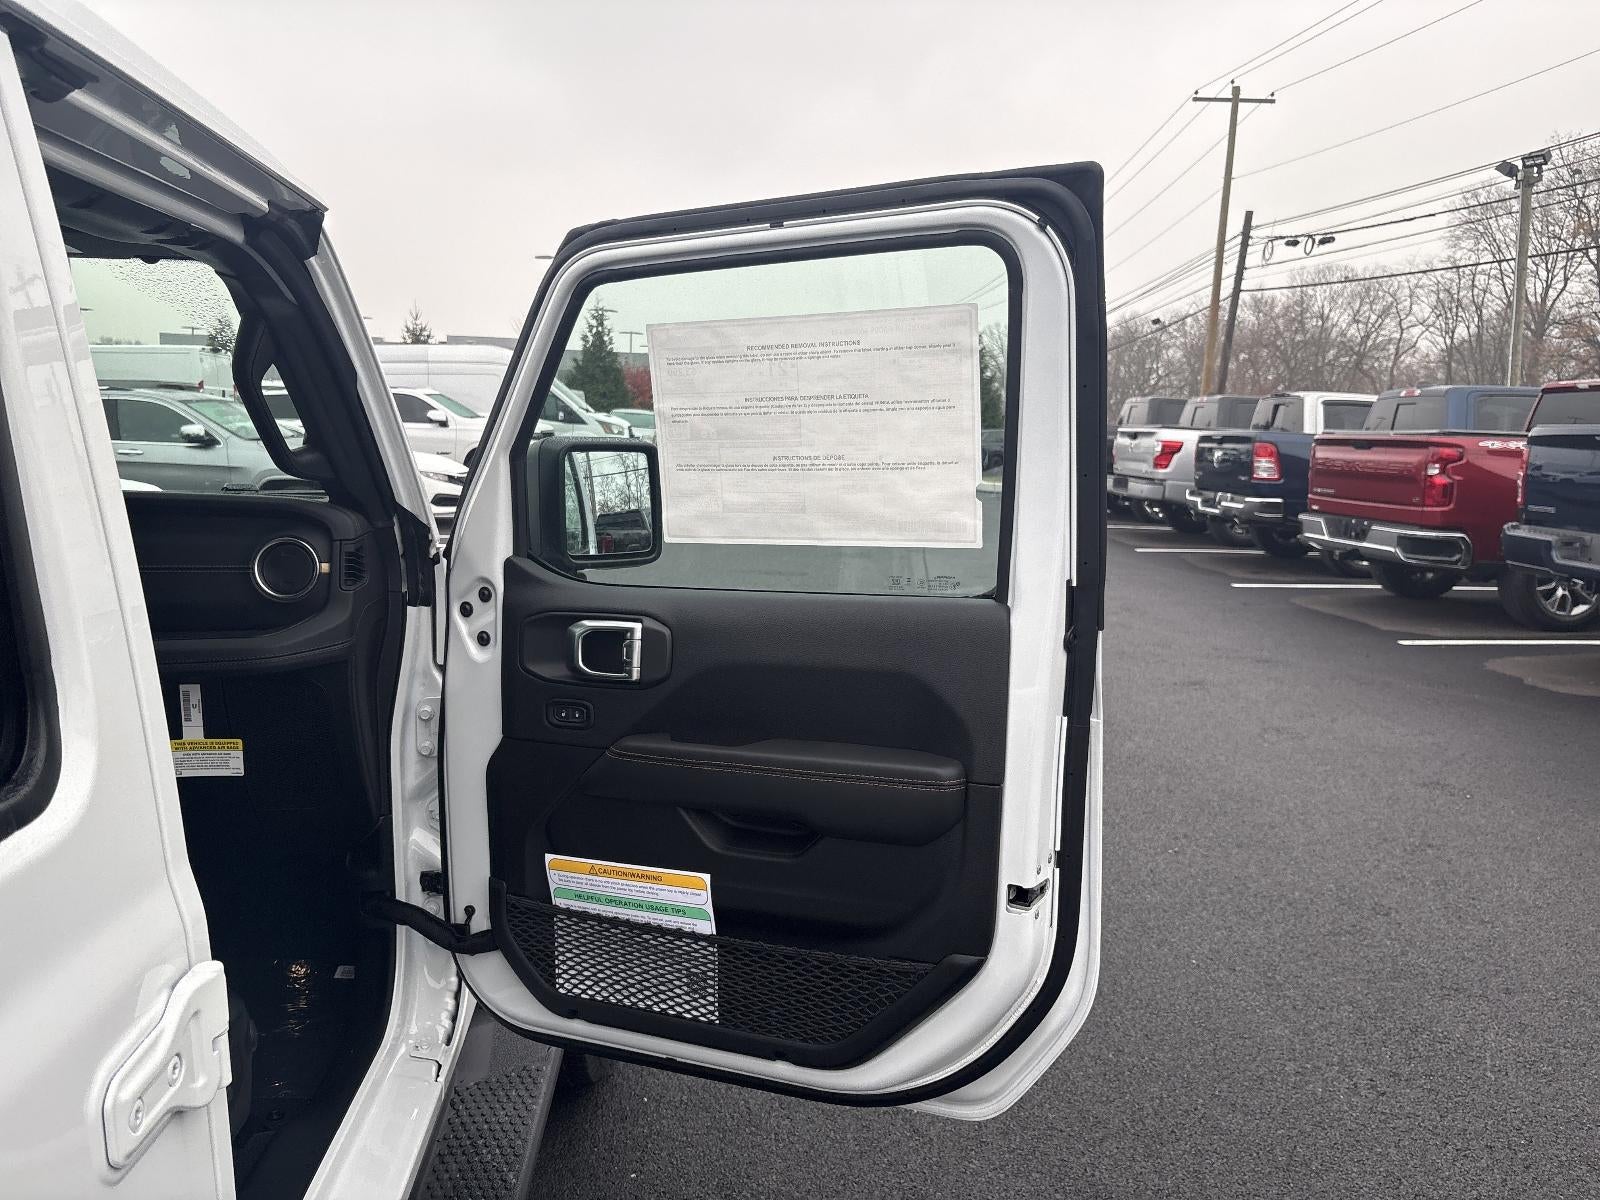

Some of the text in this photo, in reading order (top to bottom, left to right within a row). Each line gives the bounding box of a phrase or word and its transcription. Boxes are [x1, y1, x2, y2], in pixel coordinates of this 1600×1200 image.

[818, 339, 861, 347] INSTRUCTIONS
[597, 867, 663, 882] CAUTION/WARNING
[574, 892, 603, 903] HELPFUL
[604, 897, 644, 910] OPERATION
[645, 903, 670, 913] USAGE
[670, 907, 687, 916] TIPS
